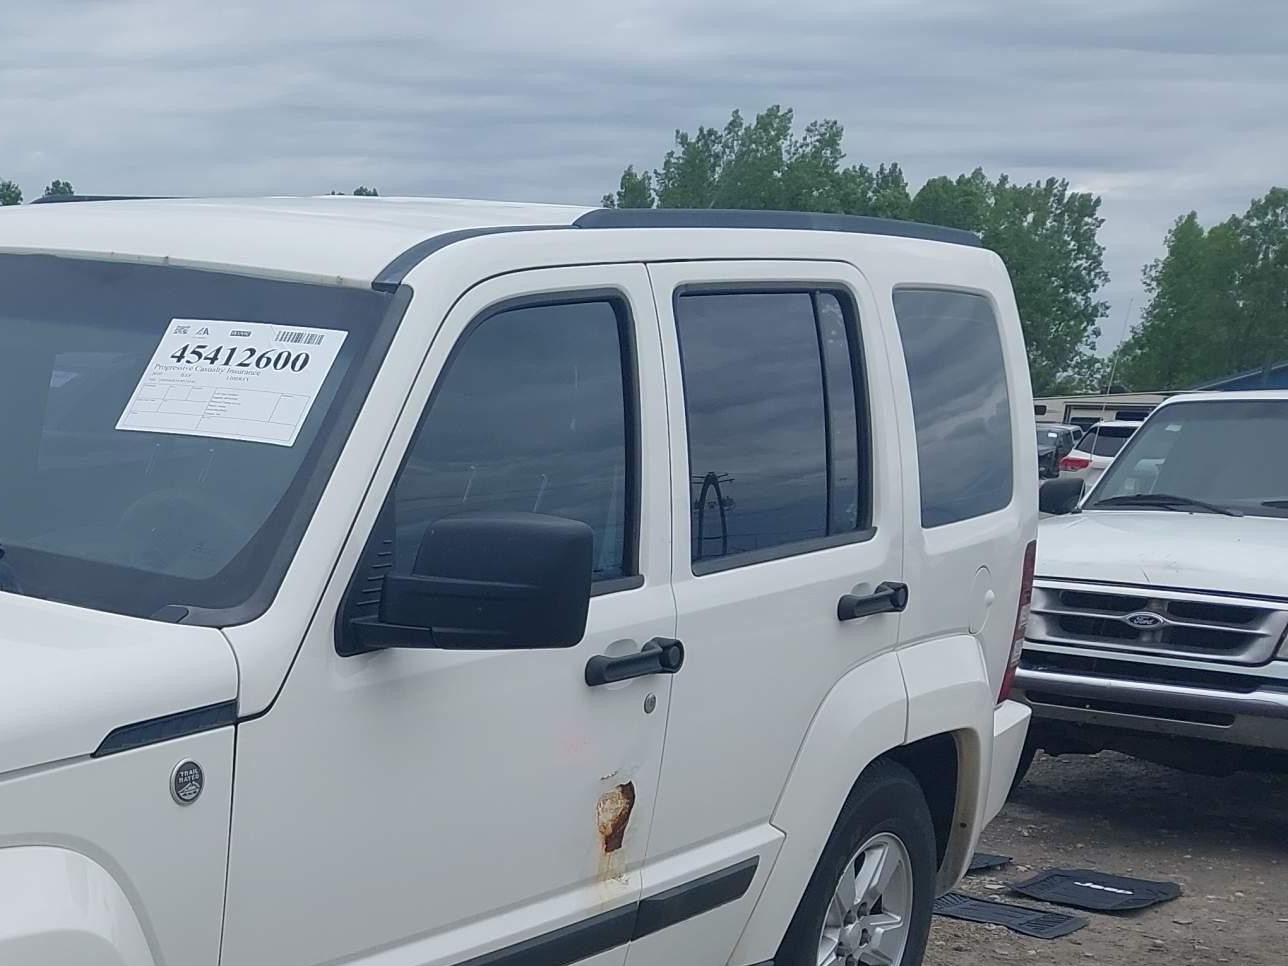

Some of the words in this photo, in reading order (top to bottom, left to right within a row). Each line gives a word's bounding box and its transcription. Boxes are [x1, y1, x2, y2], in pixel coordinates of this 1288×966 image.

[170, 343, 310, 373] 45412600
[226, 367, 261, 377] Insurance
[1073, 881, 1134, 895] Jeep
